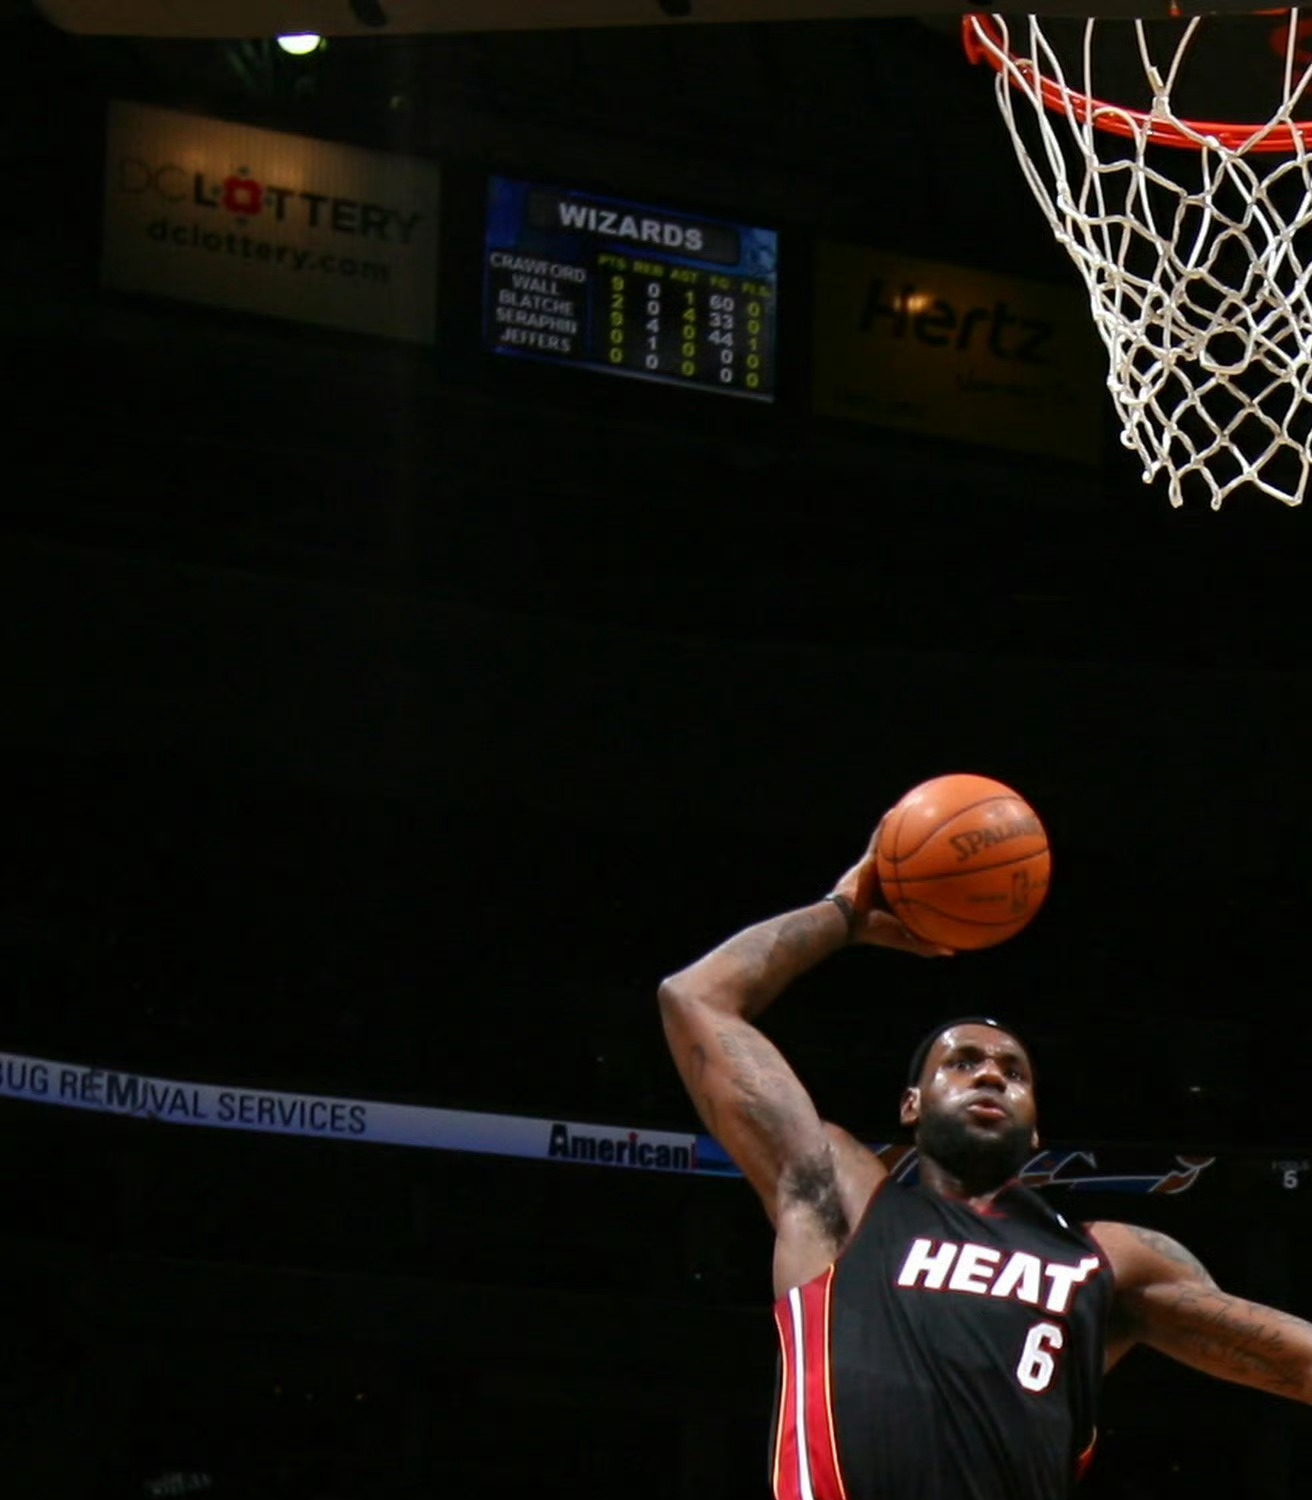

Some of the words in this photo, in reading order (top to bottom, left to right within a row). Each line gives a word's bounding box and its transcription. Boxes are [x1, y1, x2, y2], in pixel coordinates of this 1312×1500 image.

[557, 201, 704, 252] WIZARDS
[490, 251, 586, 283] CRAWFORD
[647, 282, 660, 298] 0
[686, 291, 694, 305] 1
[747, 301, 760, 318] 0
[511, 272, 560, 296] WALL
[611, 293, 624, 309] 2
[647, 300, 660, 316] 0
[682, 308, 696, 323] 4
[709, 312, 734, 330] 33
[747, 319, 760, 335] 0
[499, 288, 575, 317] BLATCHE
[645, 317, 659, 333] 4
[683, 324, 696, 341] 0
[707, 329, 734, 348] 44
[748, 337, 757, 351] 1
[610, 328, 623, 345] 0
[648, 336, 657, 351] 1
[682, 341, 695, 358] 0
[720, 349, 733, 365] 0
[746, 353, 760, 369] 0
[859, 276, 1058, 365] Hertz
[500, 326, 571, 353] JEFFERS
[610, 347, 623, 363] 0
[645, 353, 659, 370] 0
[681, 360, 695, 377] 0
[720, 367, 733, 383] 0
[746, 372, 759, 389] 0
[216, 1091, 367, 1135] SERVICES
[897, 1238, 1100, 1314] HEAT
[1016, 1321, 1065, 1393] 6
